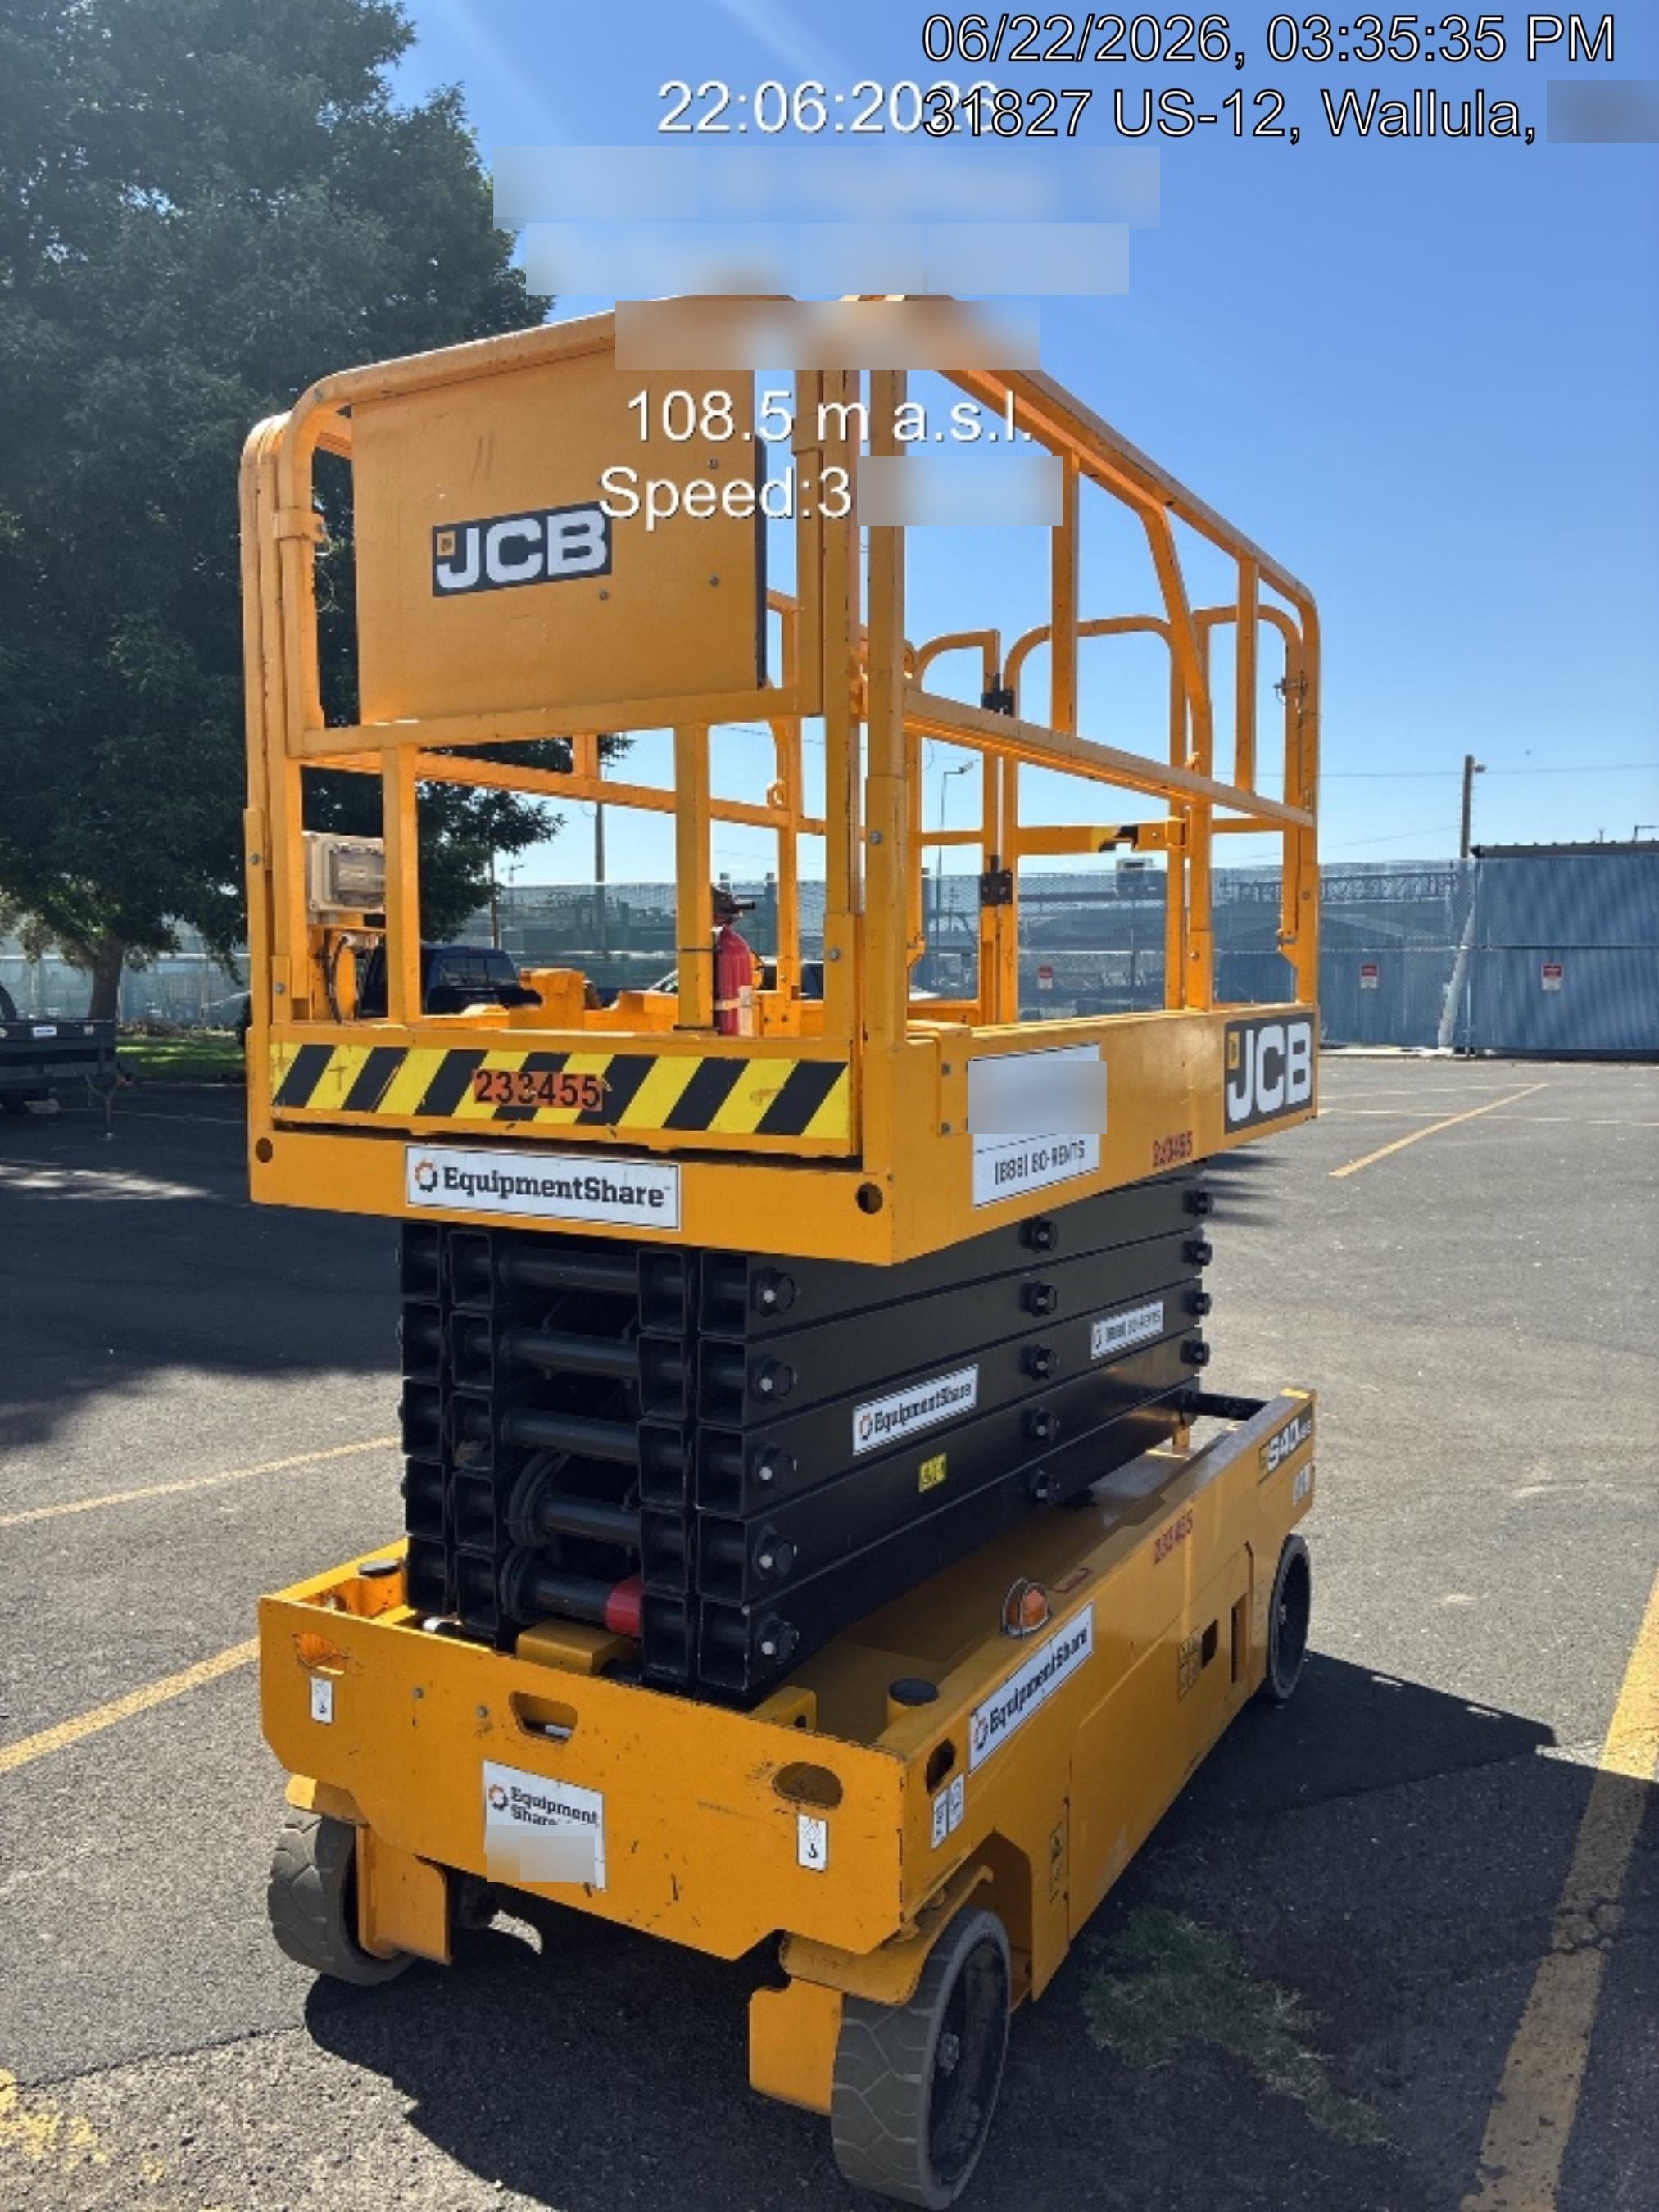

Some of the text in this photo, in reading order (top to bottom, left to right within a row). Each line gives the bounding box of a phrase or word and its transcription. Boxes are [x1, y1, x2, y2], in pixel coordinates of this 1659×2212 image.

[436, 509, 608, 591] JCB
[475, 1068, 601, 1108] 233455
[1228, 1020, 1312, 1122] JCB
[442, 1166, 665, 1208] EquipmentShare
[510, 1784, 598, 1824] Equipment
